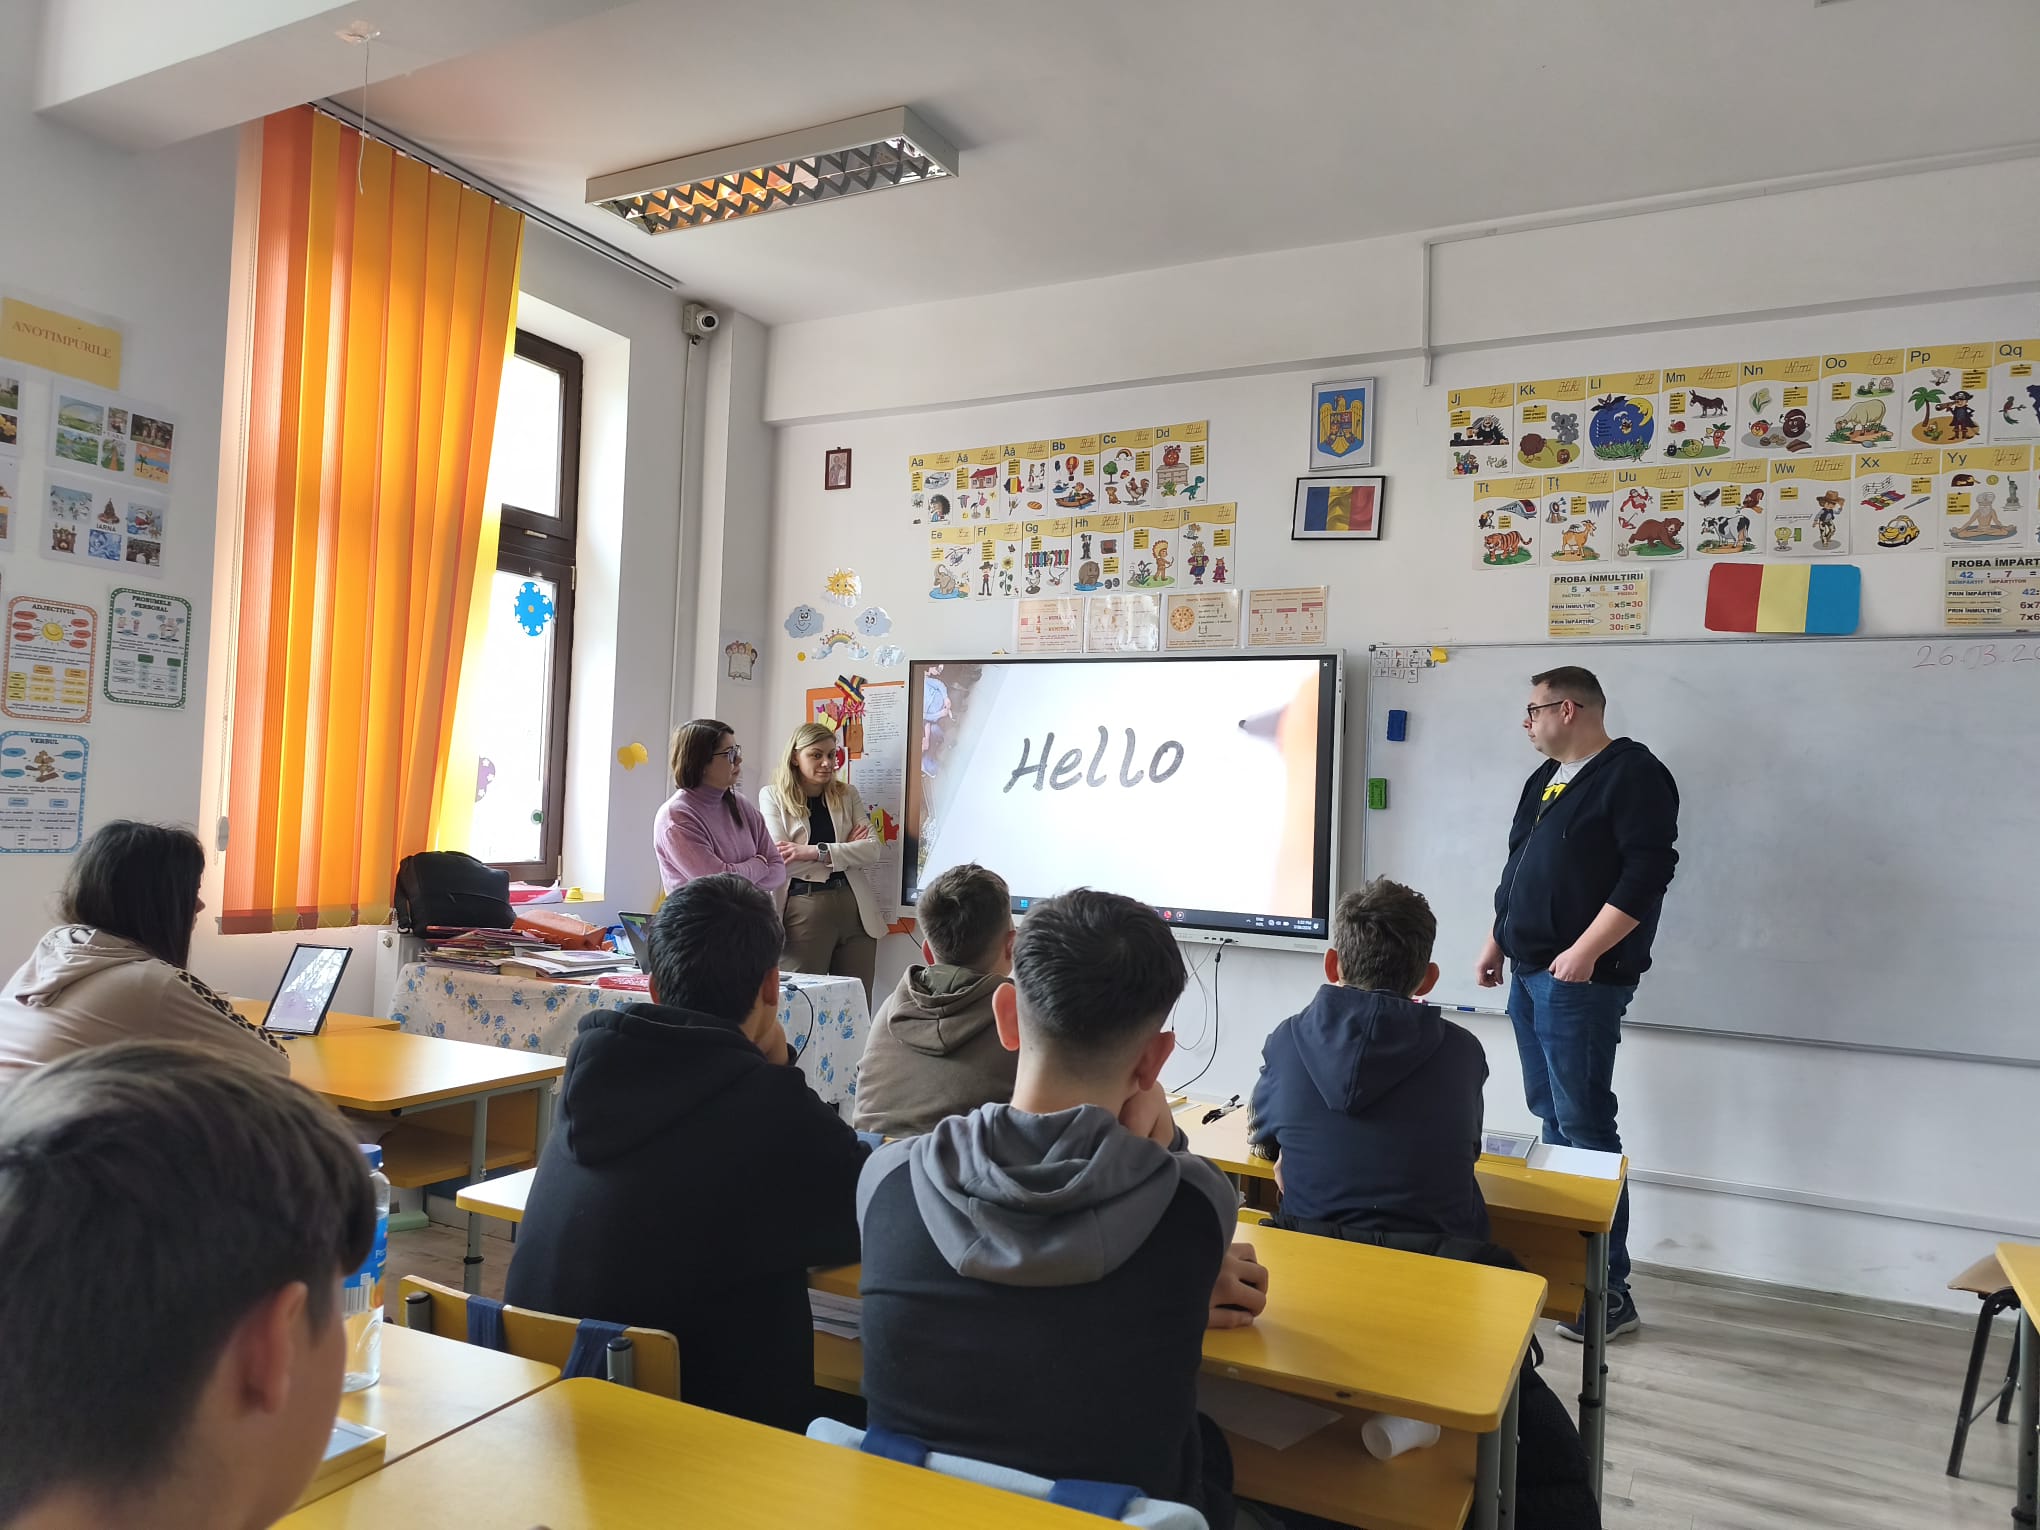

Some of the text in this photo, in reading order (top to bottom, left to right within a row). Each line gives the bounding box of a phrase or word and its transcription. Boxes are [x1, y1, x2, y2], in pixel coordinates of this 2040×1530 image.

[12, 320, 112, 359] ANOTIMPURILE
[1999, 344, 2023, 358] Qq
[1910, 350, 1931, 364] Pp
[1825, 357, 1847, 369] Oo
[1743, 364, 1763, 376] Nn
[1666, 372, 1686, 383] Mm
[1590, 378, 1601, 389] Ll
[1520, 384, 1536, 396] Kk
[1451, 392, 1461, 406] Jj
[1103, 434, 1117, 444] Cc
[1156, 428, 1170, 439] Dd
[1052, 441, 1066, 451] Bb
[911, 458, 924, 468] Aa
[1860, 456, 1880, 469] Xx
[1947, 452, 1968, 466] Yy
[1694, 465, 1713, 477] Vv
[1774, 463, 1795, 474] Ww
[1618, 471, 1637, 483] Uu
[1477, 482, 1489, 493] Tt
[96, 522, 116, 532] IARNA
[1025, 523, 1039, 534] Gg
[1075, 518, 1089, 528] Hh
[931, 530, 943, 539] Ee
[977, 526, 987, 537] Ff
[1951, 559, 1992, 568] PROBA
[1553, 575, 1587, 584] PROBA
[1959, 571, 1974, 579] 42
[2004, 570, 2013, 578] 7
[1622, 583, 1634, 591] 30
[32, 603, 77, 615] ADJECTIVUL
[134, 603, 169, 613] PERSONAL
[30, 737, 59, 745] VERBUL
[1002, 725, 1185, 794] Hello
